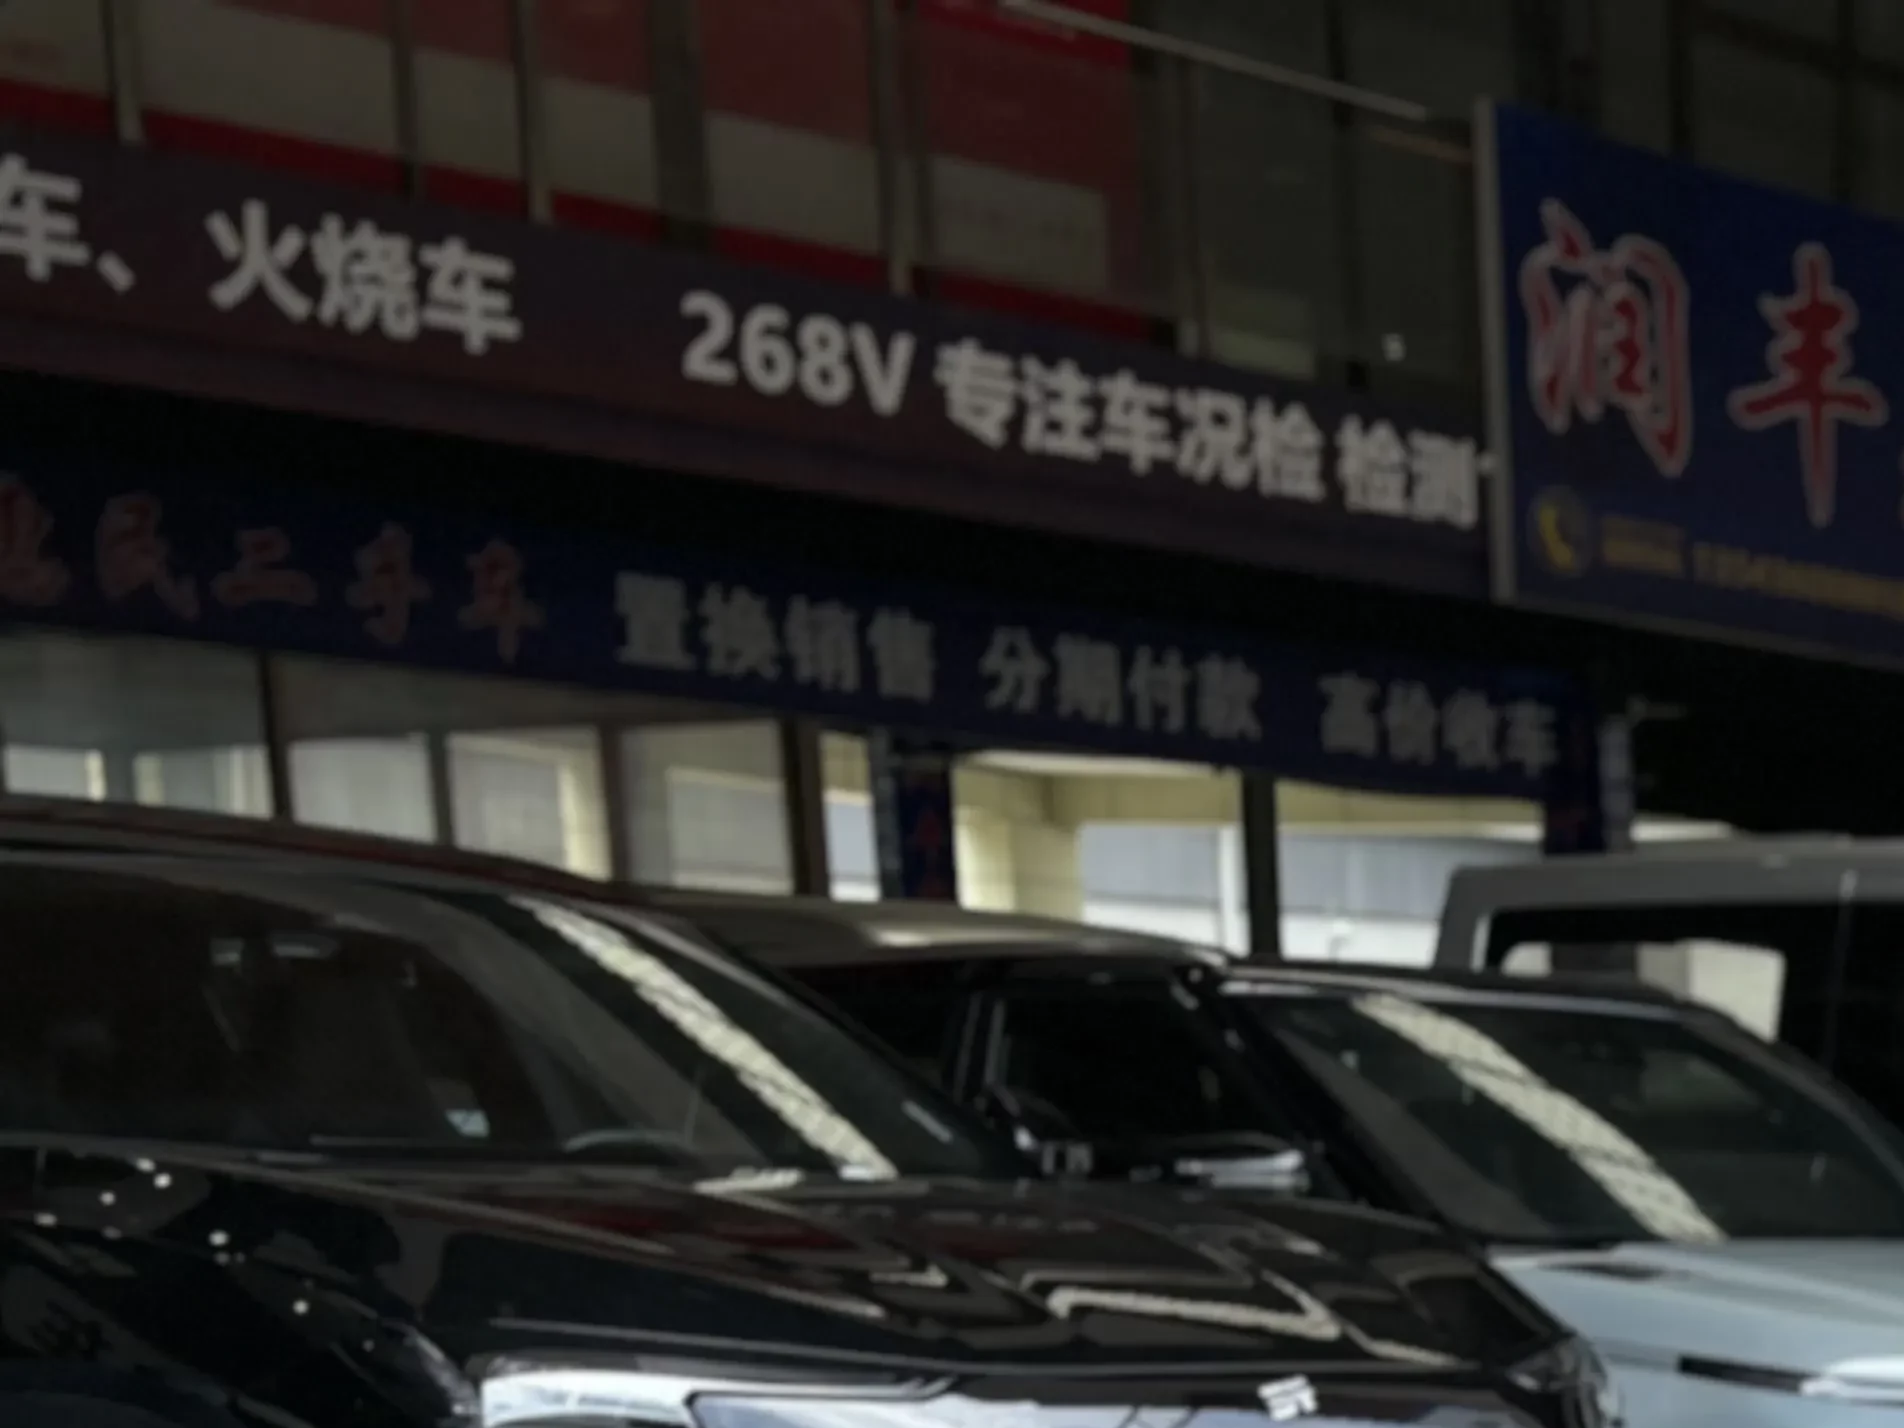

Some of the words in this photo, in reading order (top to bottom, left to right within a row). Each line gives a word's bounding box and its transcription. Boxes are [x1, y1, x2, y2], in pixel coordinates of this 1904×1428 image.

[680, 288, 915, 416] 268V
[614, 570, 936, 703] 置换销售
[979, 625, 1263, 742] 分期付款
[1318, 672, 1559, 778] 高价收车
